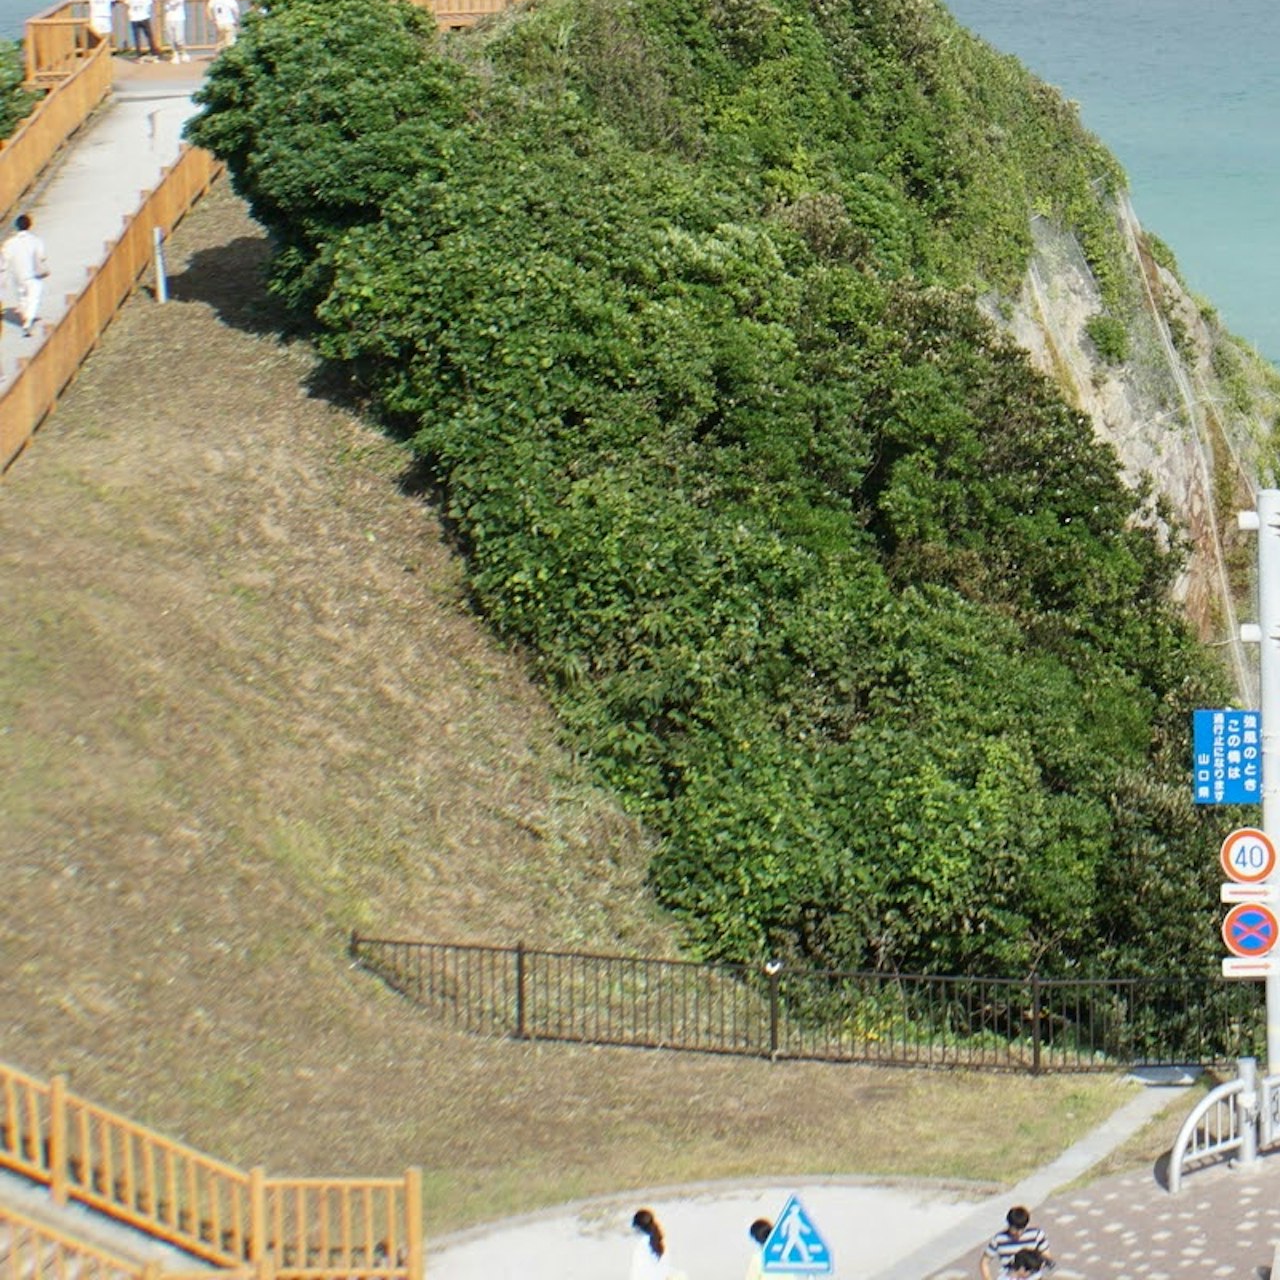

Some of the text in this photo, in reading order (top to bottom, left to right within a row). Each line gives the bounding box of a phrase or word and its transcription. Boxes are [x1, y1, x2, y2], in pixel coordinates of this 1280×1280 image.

[1198, 753, 1210, 798] 山口県
[1235, 846, 1263, 869] 40
